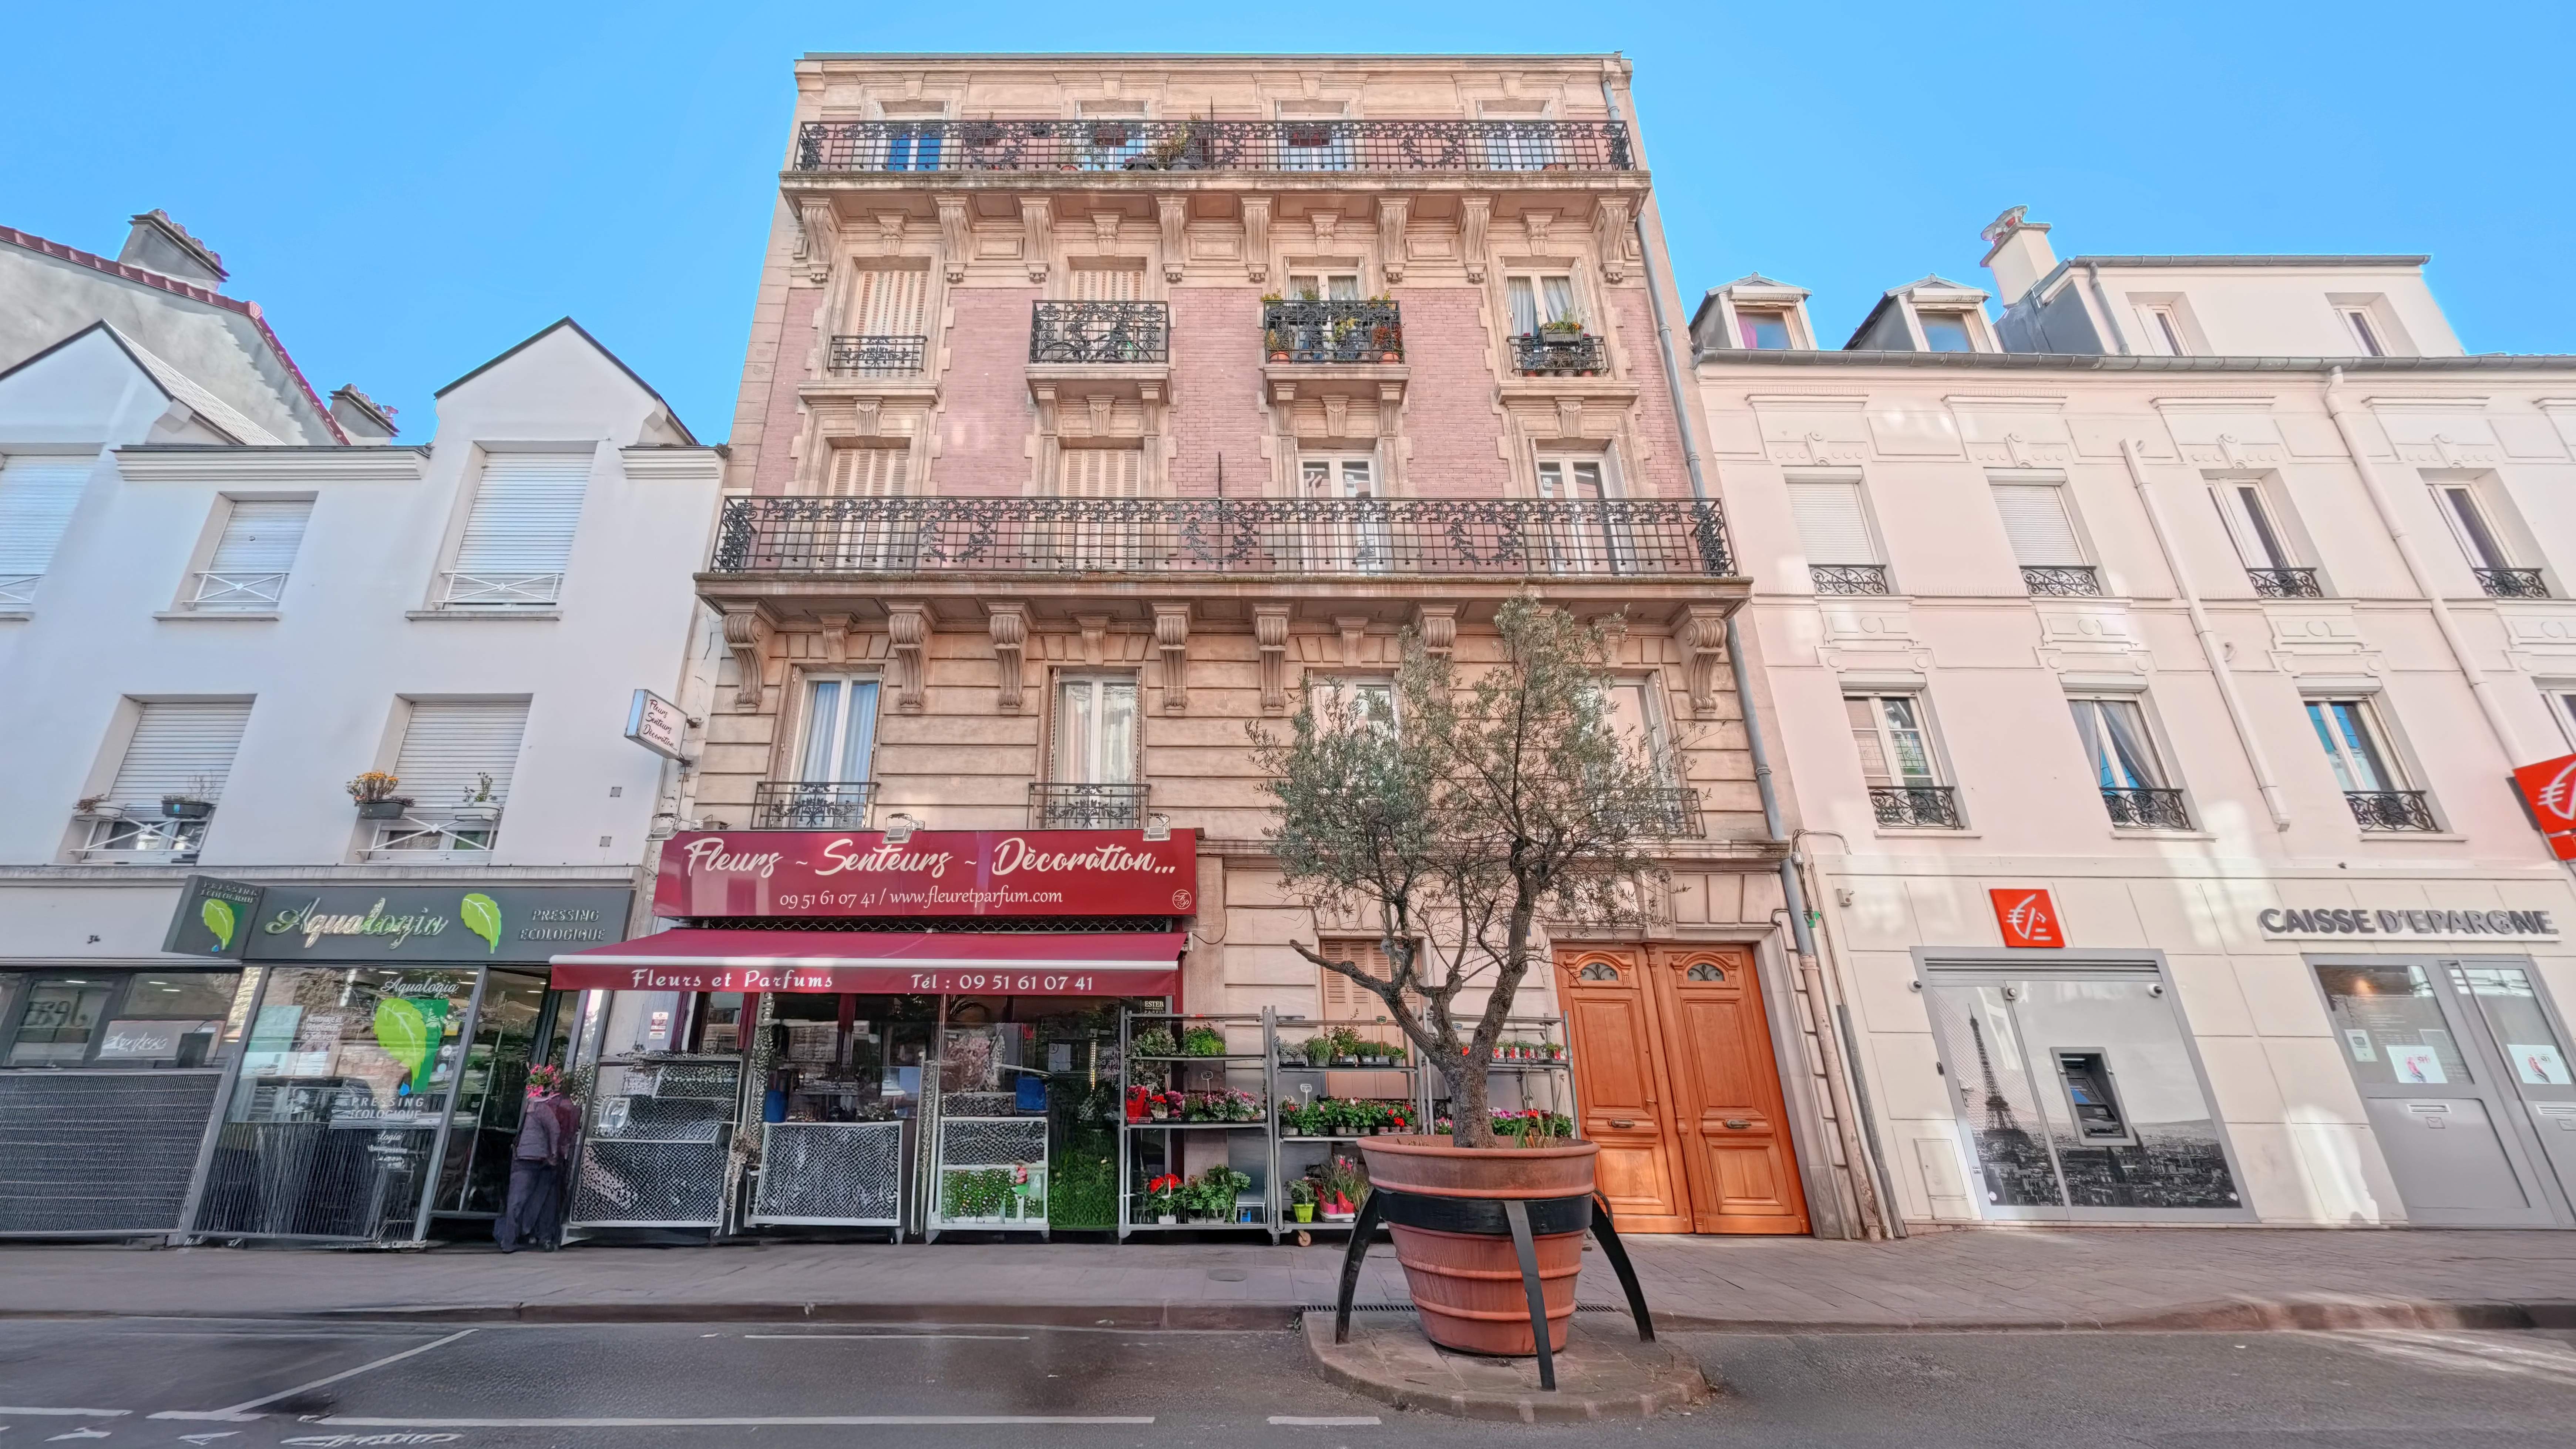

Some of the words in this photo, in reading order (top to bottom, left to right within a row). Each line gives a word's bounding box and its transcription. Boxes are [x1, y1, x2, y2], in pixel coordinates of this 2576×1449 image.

[649, 699, 669, 718] Fleurs
[645, 712, 673, 734] Senteurs
[684, 838, 784, 878] Fleurs
[815, 838, 954, 878] Senteurs
[780, 895, 798, 909] 09
[801, 895, 815, 909] 51
[820, 890, 834, 904] 61
[839, 894, 857, 908] 07
[861, 893, 875, 908] 41
[890, 885, 1063, 908] www.fleuretparfum.com
[532, 909, 599, 921] PRESSING
[2260, 908, 2377, 934] CAISSE
[2376, 910, 2559, 934] D'EPARGNE
[519, 928, 606, 941] ECOLOGIQUE
[380, 976, 460, 998] Aqualogia
[632, 969, 701, 988] Fleurs
[712, 973, 732, 987] et
[744, 969, 832, 989] Parfums
[911, 974, 937, 988] Tél
[959, 975, 985, 989] 09
[992, 975, 1009, 989] 51
[1018, 976, 1036, 989] 61
[1045, 976, 1069, 990] 07
[1075, 977, 1092, 990] 41
[352, 1097, 424, 1107] PRESSING
